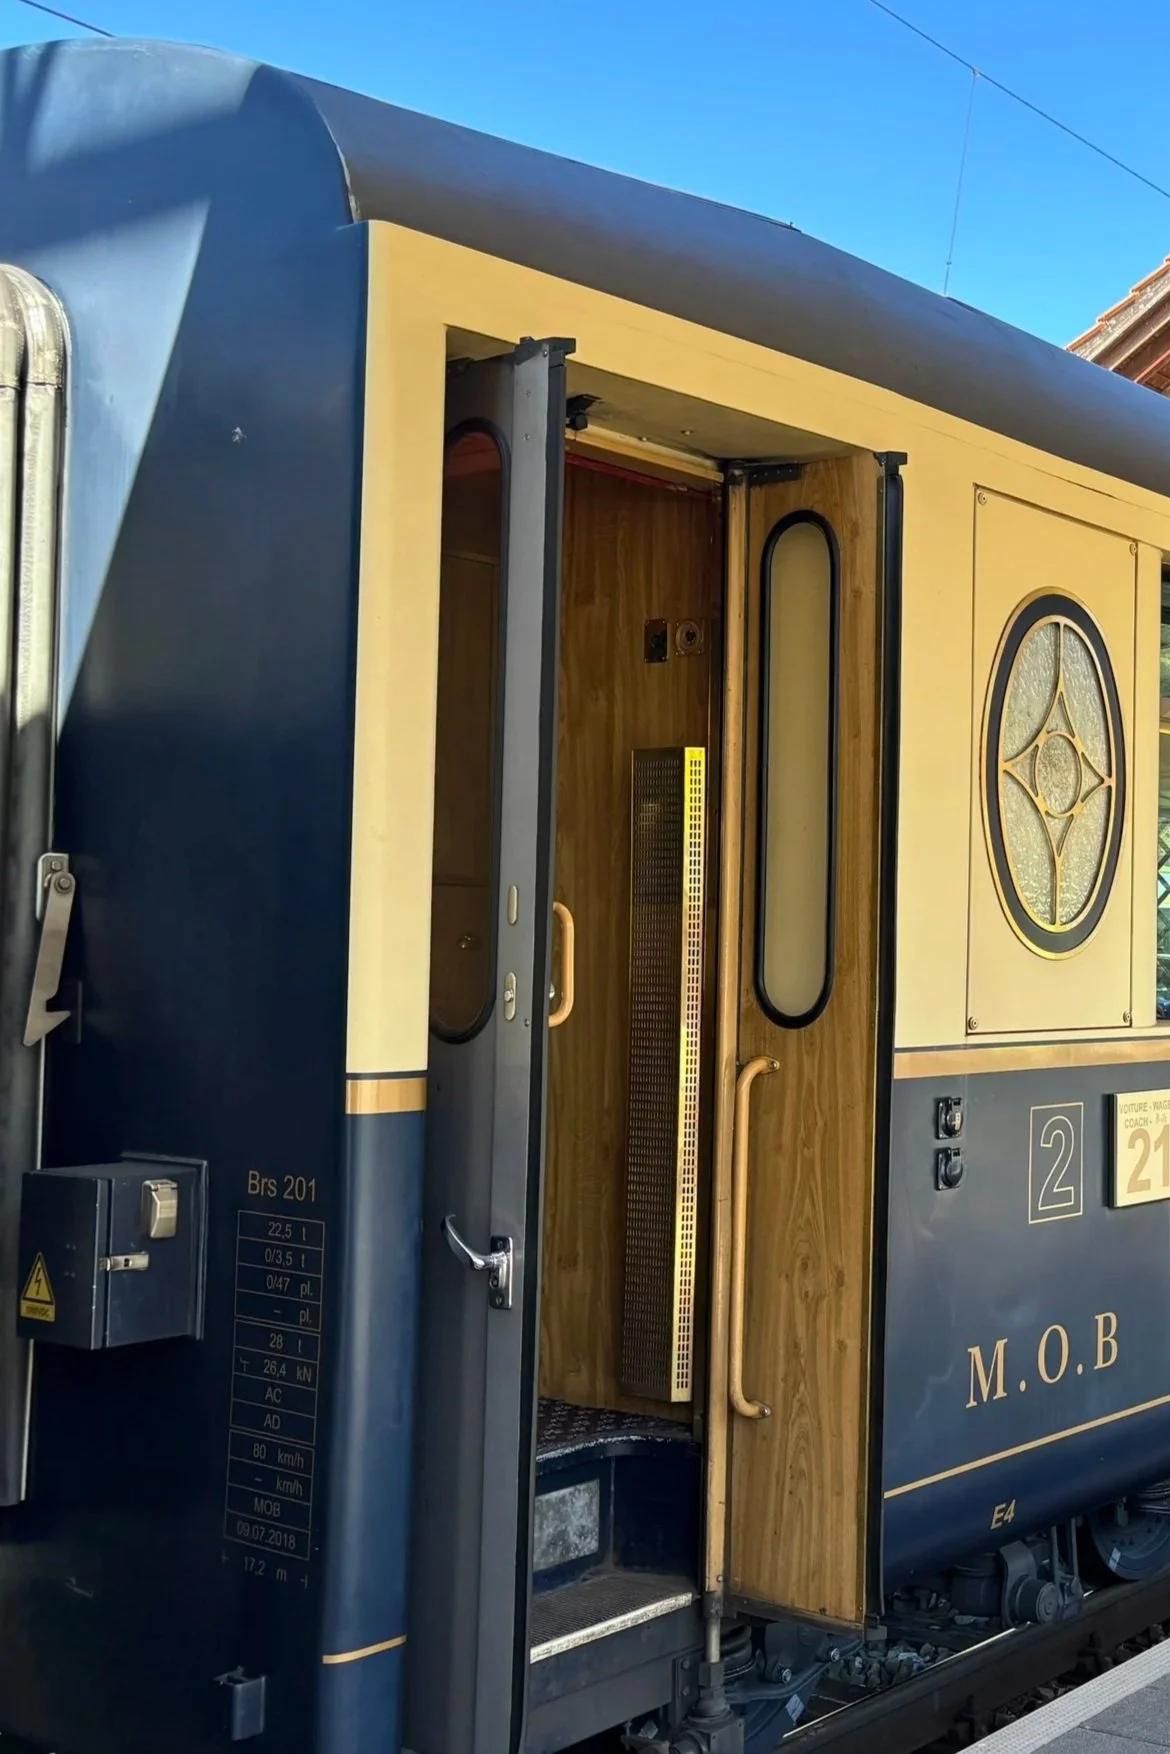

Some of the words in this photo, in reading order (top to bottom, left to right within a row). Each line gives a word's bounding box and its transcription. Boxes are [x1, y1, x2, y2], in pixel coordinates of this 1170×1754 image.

[1119, 1102, 1148, 1114] VOITURE
[1124, 1117, 1148, 1129] COACH
[1038, 1115, 1075, 1211] 2
[1127, 1124, 1170, 1194] 21
[247, 1169, 277, 1198] Brs
[282, 1174, 316, 1203] 201
[267, 1220, 292, 1240] 22,5
[264, 1248, 293, 1267] 0/3,5
[266, 1274, 290, 1293] 0/47
[269, 1332, 283, 1349] 28
[263, 1358, 287, 1379] 26,4
[296, 1365, 312, 1384] kN
[265, 1386, 282, 1403] AC
[263, 1413, 281, 1430] AD
[253, 1443, 267, 1460] 80
[277, 1447, 304, 1469] km/h
[276, 1475, 303, 1497] km/h
[253, 1497, 281, 1518] MOB
[990, 1499, 1016, 1530] E4
[275, 1567, 287, 1583] m
